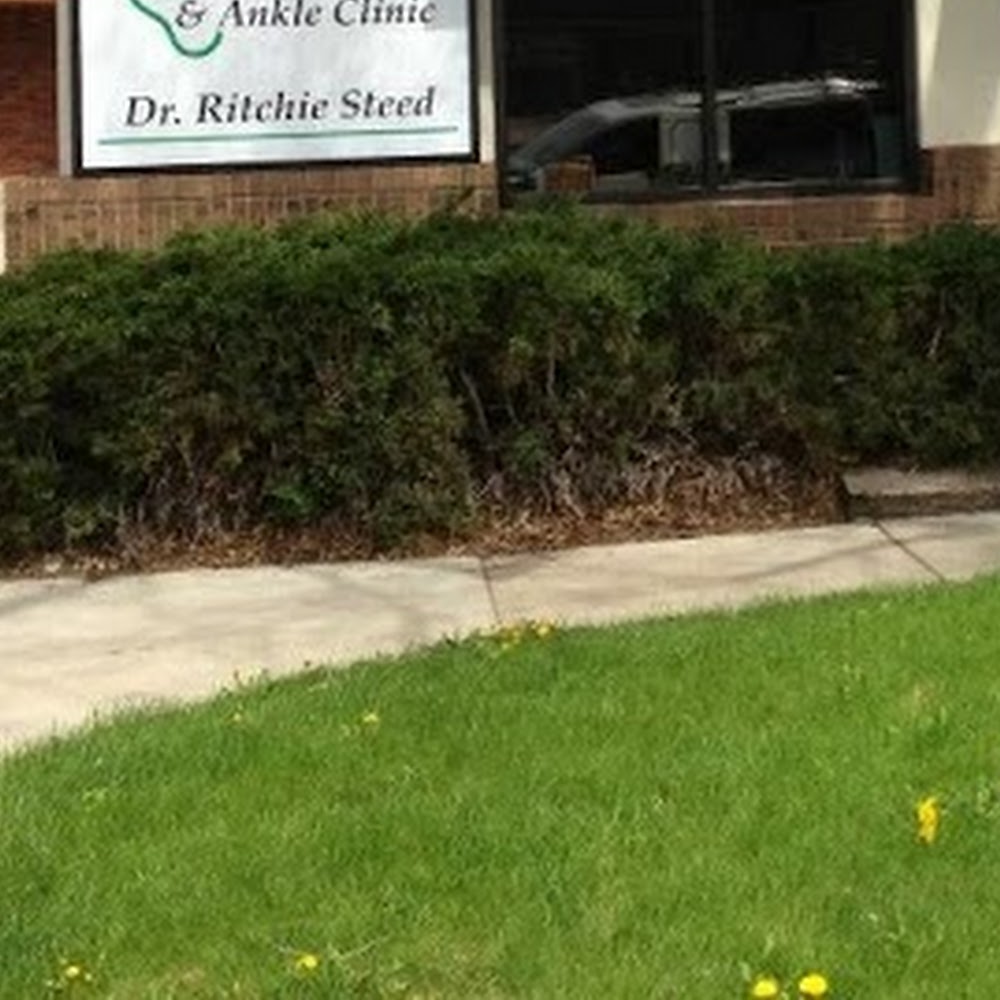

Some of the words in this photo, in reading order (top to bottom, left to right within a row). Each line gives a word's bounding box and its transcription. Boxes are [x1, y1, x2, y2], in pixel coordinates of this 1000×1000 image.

[174, 0, 207, 30] &
[125, 96, 182, 127] Dr.
[196, 92, 329, 124] Ritchie
[340, 86, 436, 119] Steed
